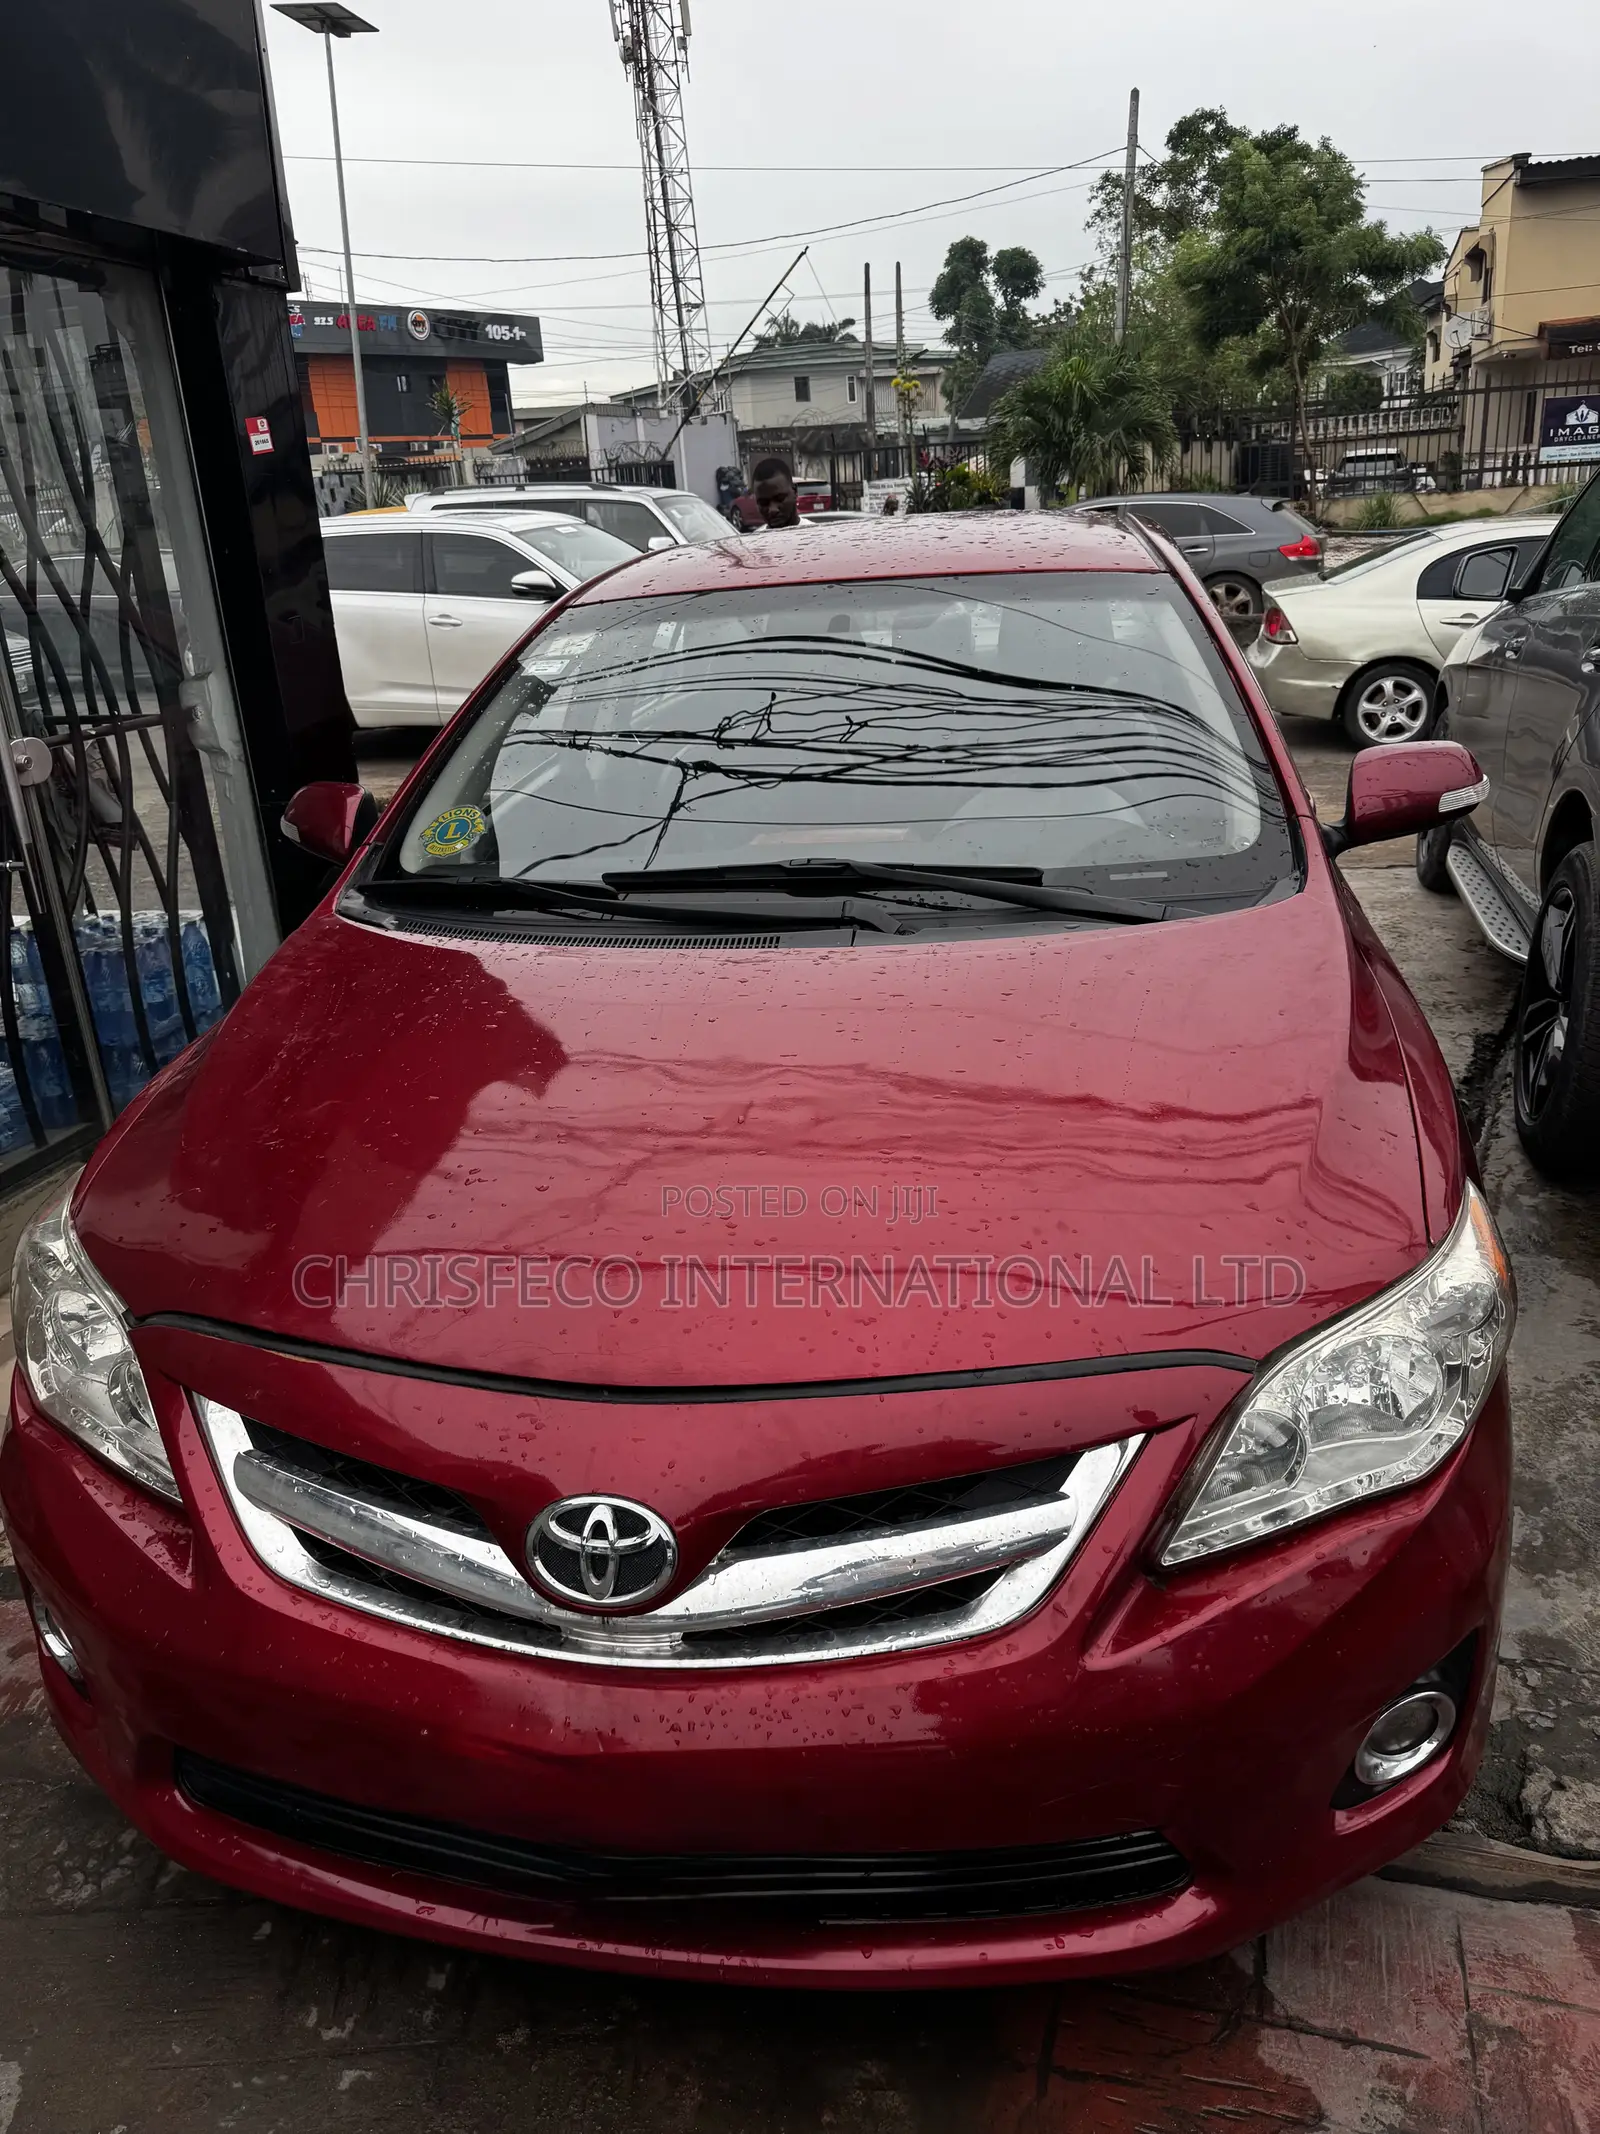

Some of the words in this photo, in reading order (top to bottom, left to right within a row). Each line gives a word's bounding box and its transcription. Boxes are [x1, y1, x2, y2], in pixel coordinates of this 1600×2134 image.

[1568, 345, 1593, 354] Tel:
[442, 809, 477, 820] LIONS
[444, 822, 461, 839] L
